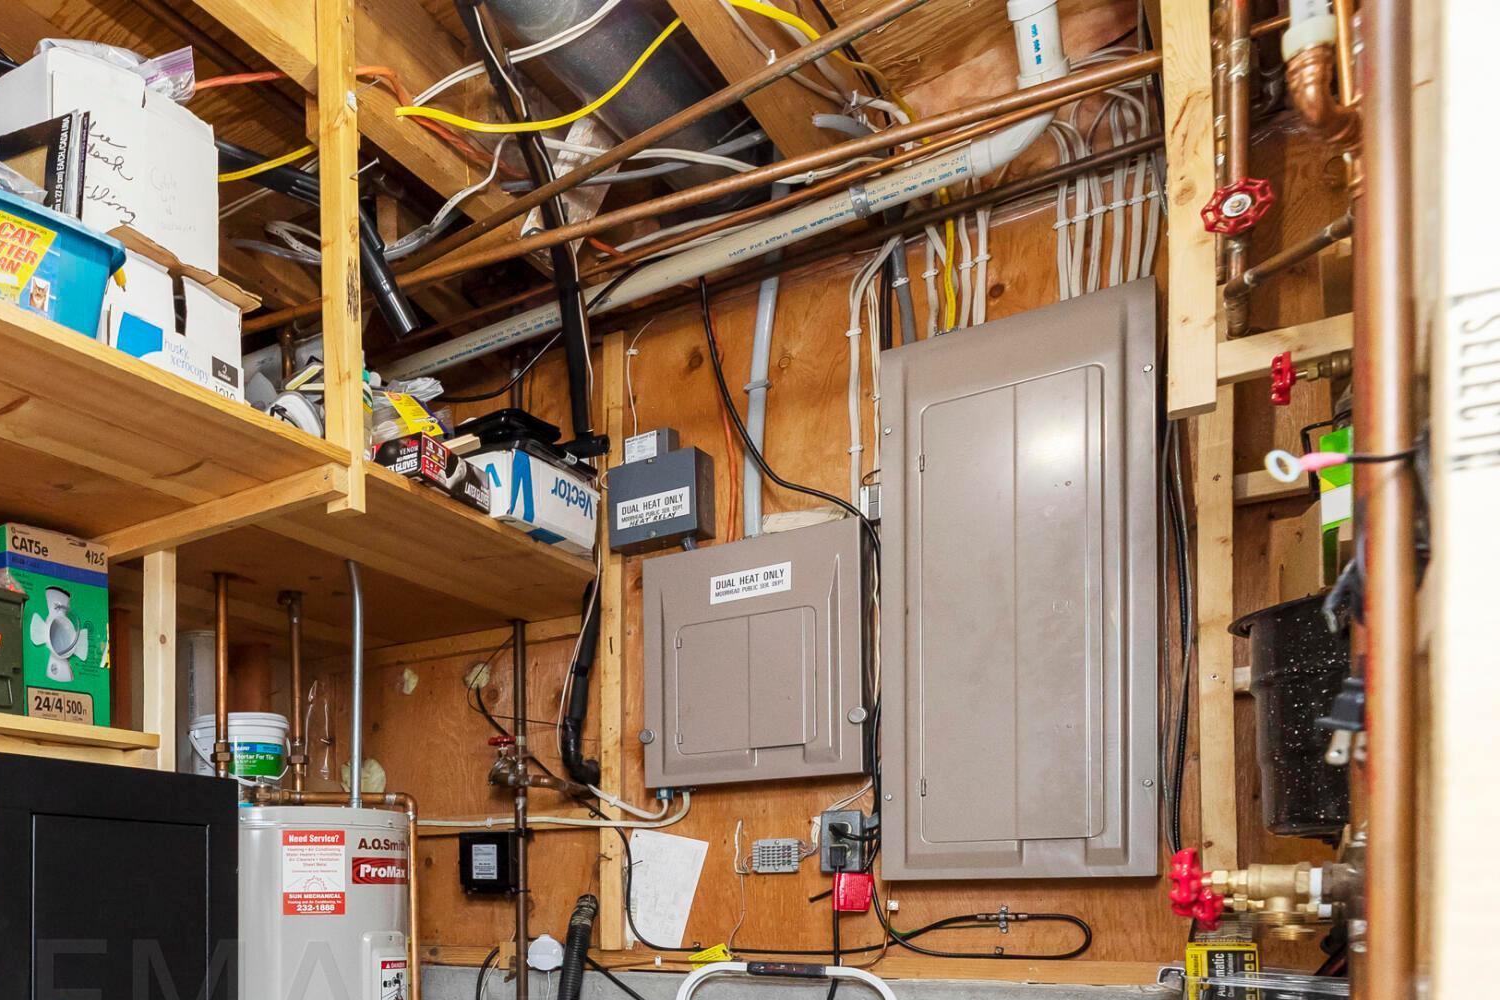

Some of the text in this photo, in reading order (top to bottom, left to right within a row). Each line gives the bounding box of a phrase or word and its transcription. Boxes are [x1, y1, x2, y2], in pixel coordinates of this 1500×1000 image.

[170, 356, 209, 383] xerocopy
[396, 458, 418, 472] GLOVES
[551, 477, 594, 521] Vector
[621, 493, 684, 516] DUAL HEAT ONLY
[653, 511, 677, 521] RELAY
[11, 536, 49, 557] CAT5e
[715, 569, 785, 590] DUAL HEAT ONLY
[35, 695, 63, 713] 24/4
[288, 833, 340, 843] Need Service?
[359, 864, 406, 879] ProMax
